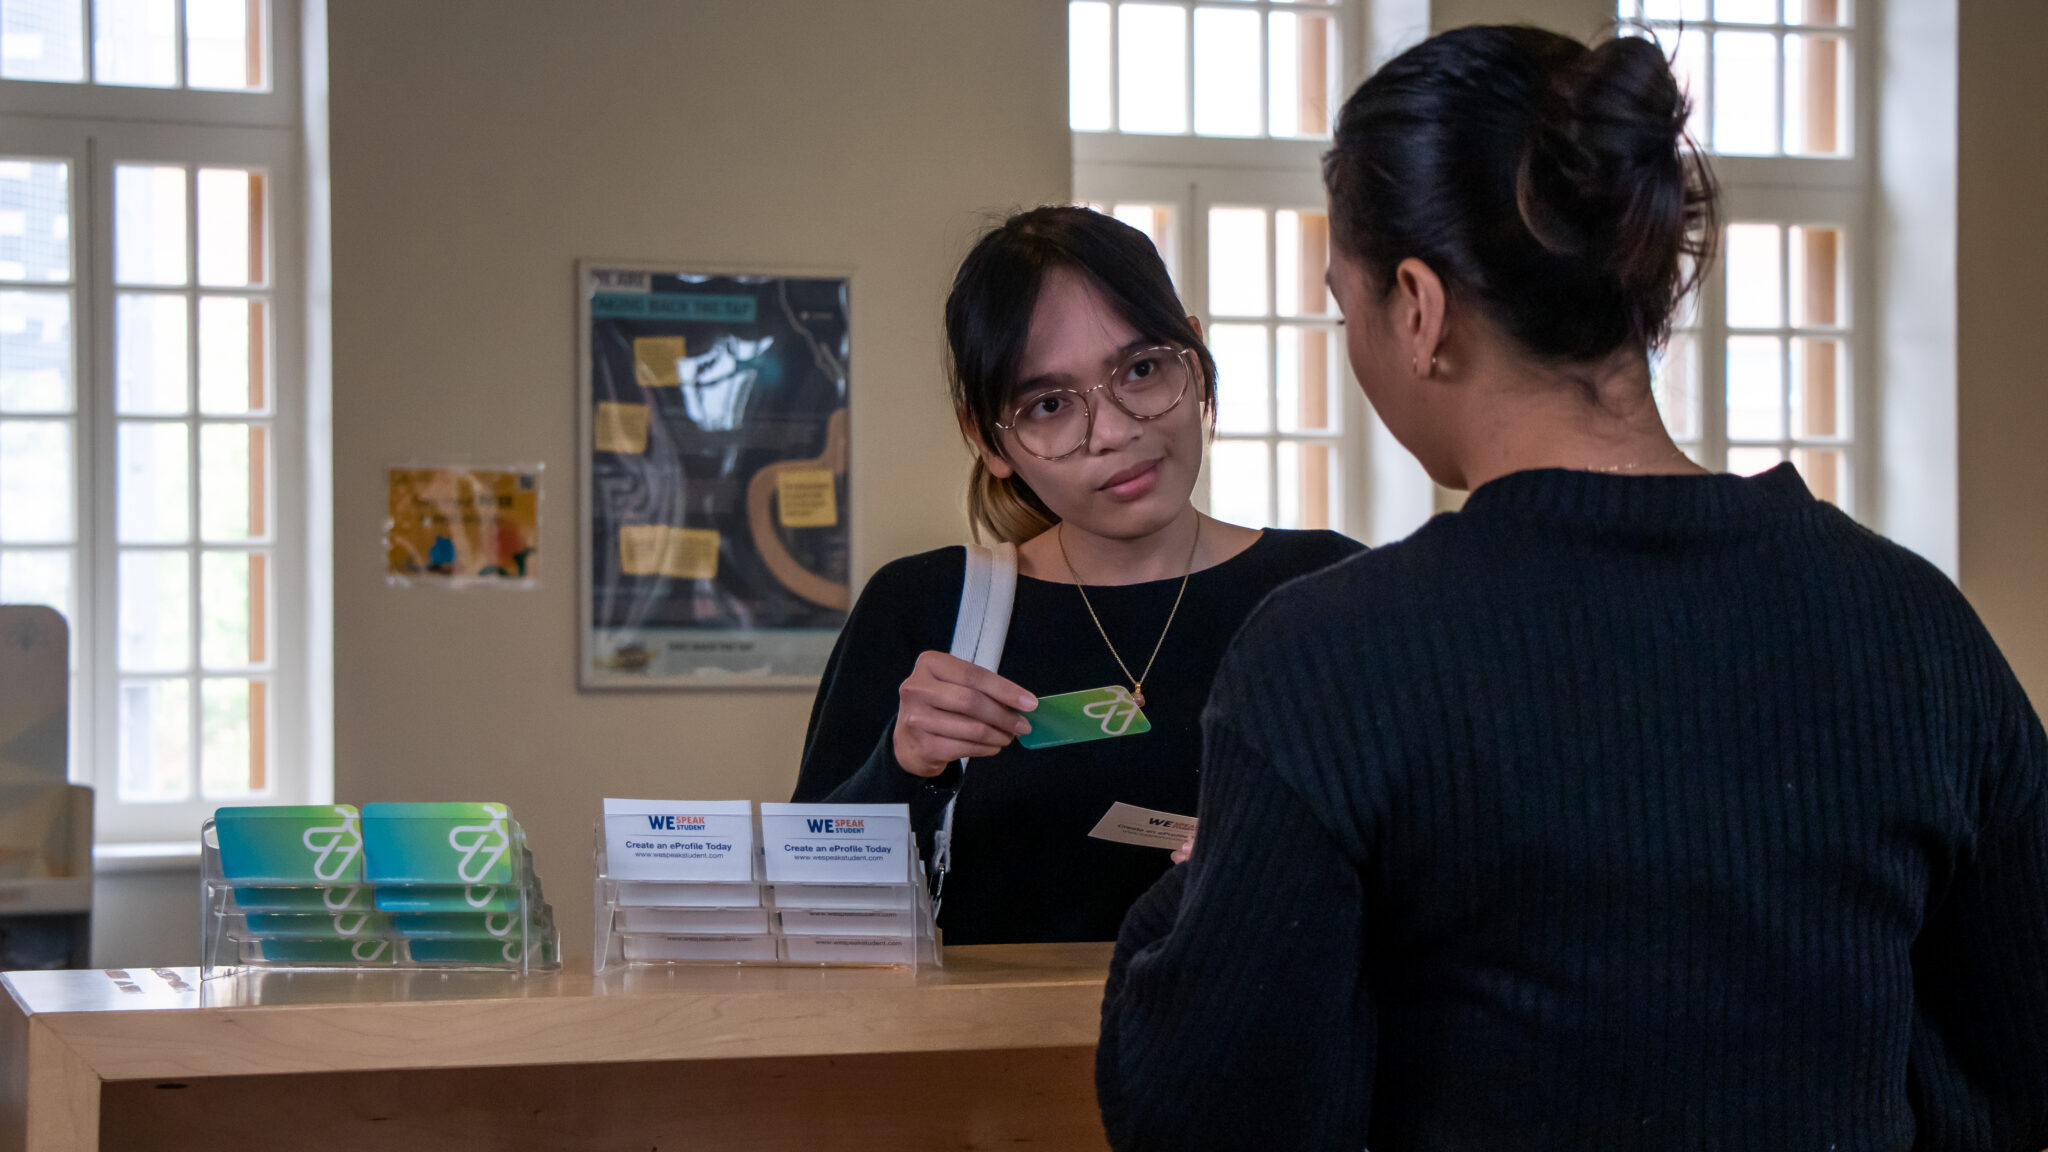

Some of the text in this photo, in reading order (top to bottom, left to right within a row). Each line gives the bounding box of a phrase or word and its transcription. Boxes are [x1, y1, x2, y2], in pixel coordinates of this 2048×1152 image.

[648, 815, 705, 830] WE SPEAK
[806, 818, 864, 833] WE SPEAK
[1149, 817, 1175, 828] WE
[625, 840, 732, 852] Create an eProfile Today
[784, 844, 892, 854] Create an eProfile Today
